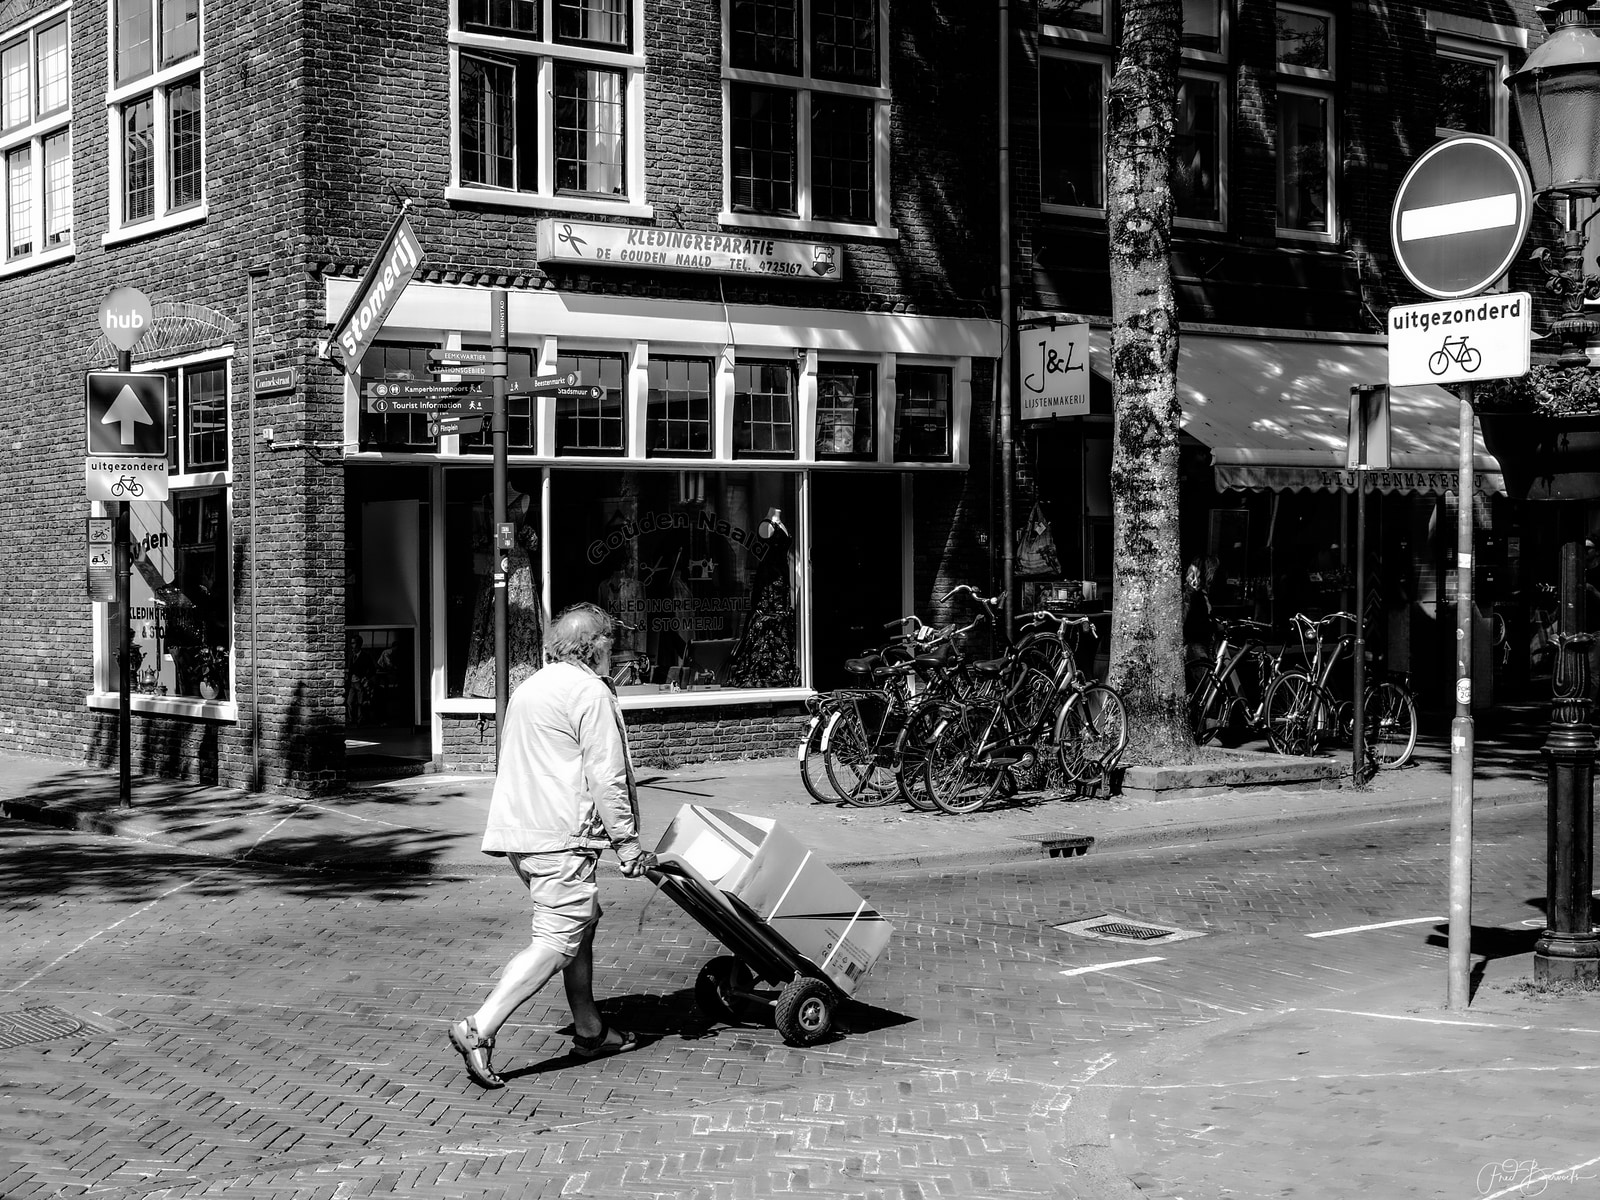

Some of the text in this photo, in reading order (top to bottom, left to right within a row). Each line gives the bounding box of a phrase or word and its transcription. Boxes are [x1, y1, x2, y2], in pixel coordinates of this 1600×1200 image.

[627, 229, 775, 256] KLEDINGREPARATIE
[596, 247, 611, 260] DE
[620, 249, 667, 264] GOUDEN
[675, 254, 712, 268] NAALD
[758, 260, 802, 274] 4725167
[342, 229, 417, 357] stomerij
[106, 309, 144, 328] hub
[1393, 299, 1521, 333] uitgezonderd
[444, 352, 487, 361] EEMKWARTIER
[433, 366, 486, 374] STATIONSGEBIED
[1024, 340, 1084, 393] J&L
[404, 385, 469, 394] Kamperbinnenpoort
[534, 377, 566, 388] Beestenmarkt
[557, 387, 588, 396] Stadsmuur
[392, 401, 462, 409] Tourist Information
[1024, 394, 1085, 409] LIJSTENMAKERIJ
[91, 462, 164, 473] uitgezonderd
[1322, 471, 1483, 488] LIJTENMAKERJ
[586, 510, 770, 565] Gouden Naald
[607, 597, 752, 614] KLEDINGREPARATIE
[651, 616, 724, 632] STOMERIJ
